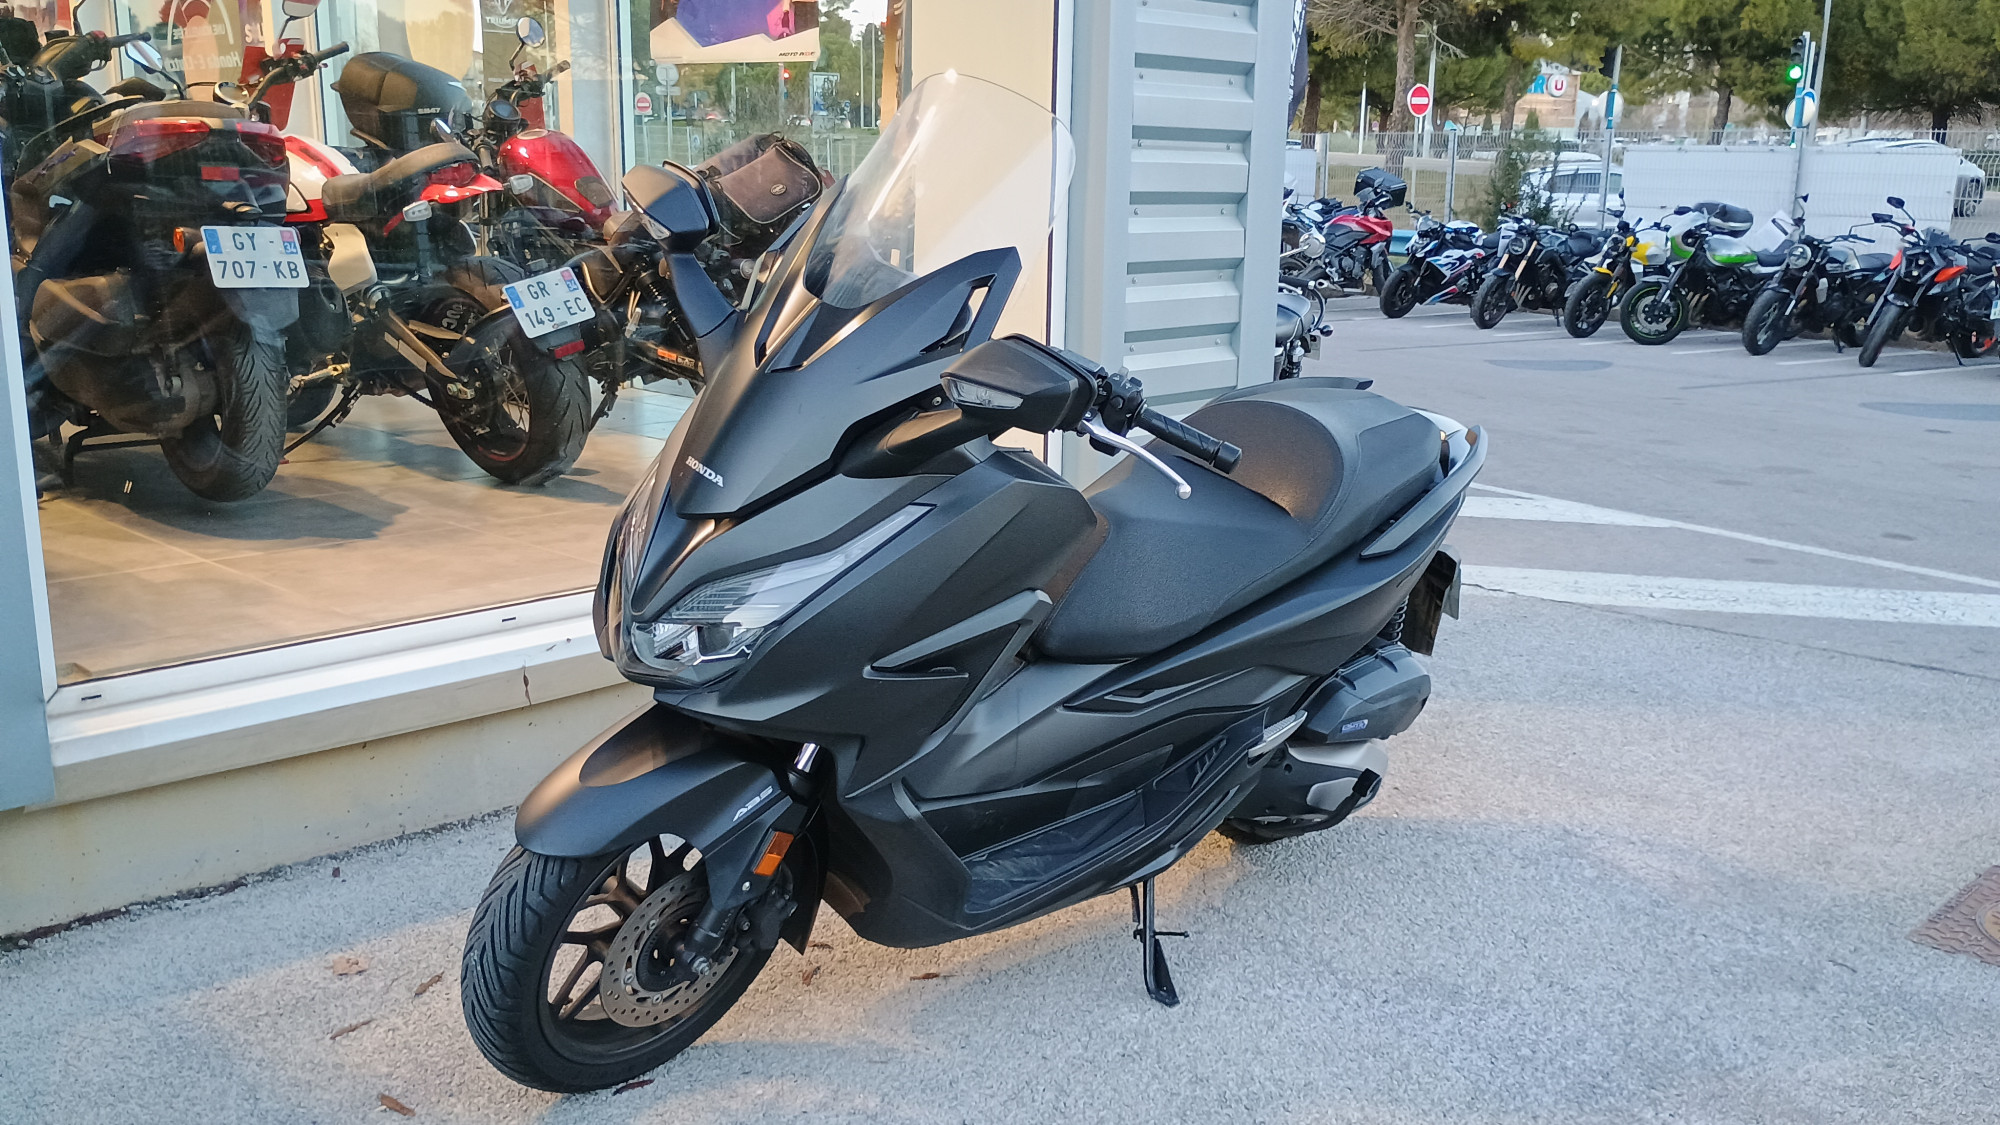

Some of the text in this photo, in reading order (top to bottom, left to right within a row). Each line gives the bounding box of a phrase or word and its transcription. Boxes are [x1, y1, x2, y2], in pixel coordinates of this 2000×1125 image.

[485, 16, 518, 25] TRIUMP
[232, 232, 256, 252] GY
[284, 242, 297, 253] 34
[527, 281, 550, 300] GR
[566, 280, 579, 291] 34
[685, 455, 724, 488] HONDA
[732, 785, 774, 822] ABS
